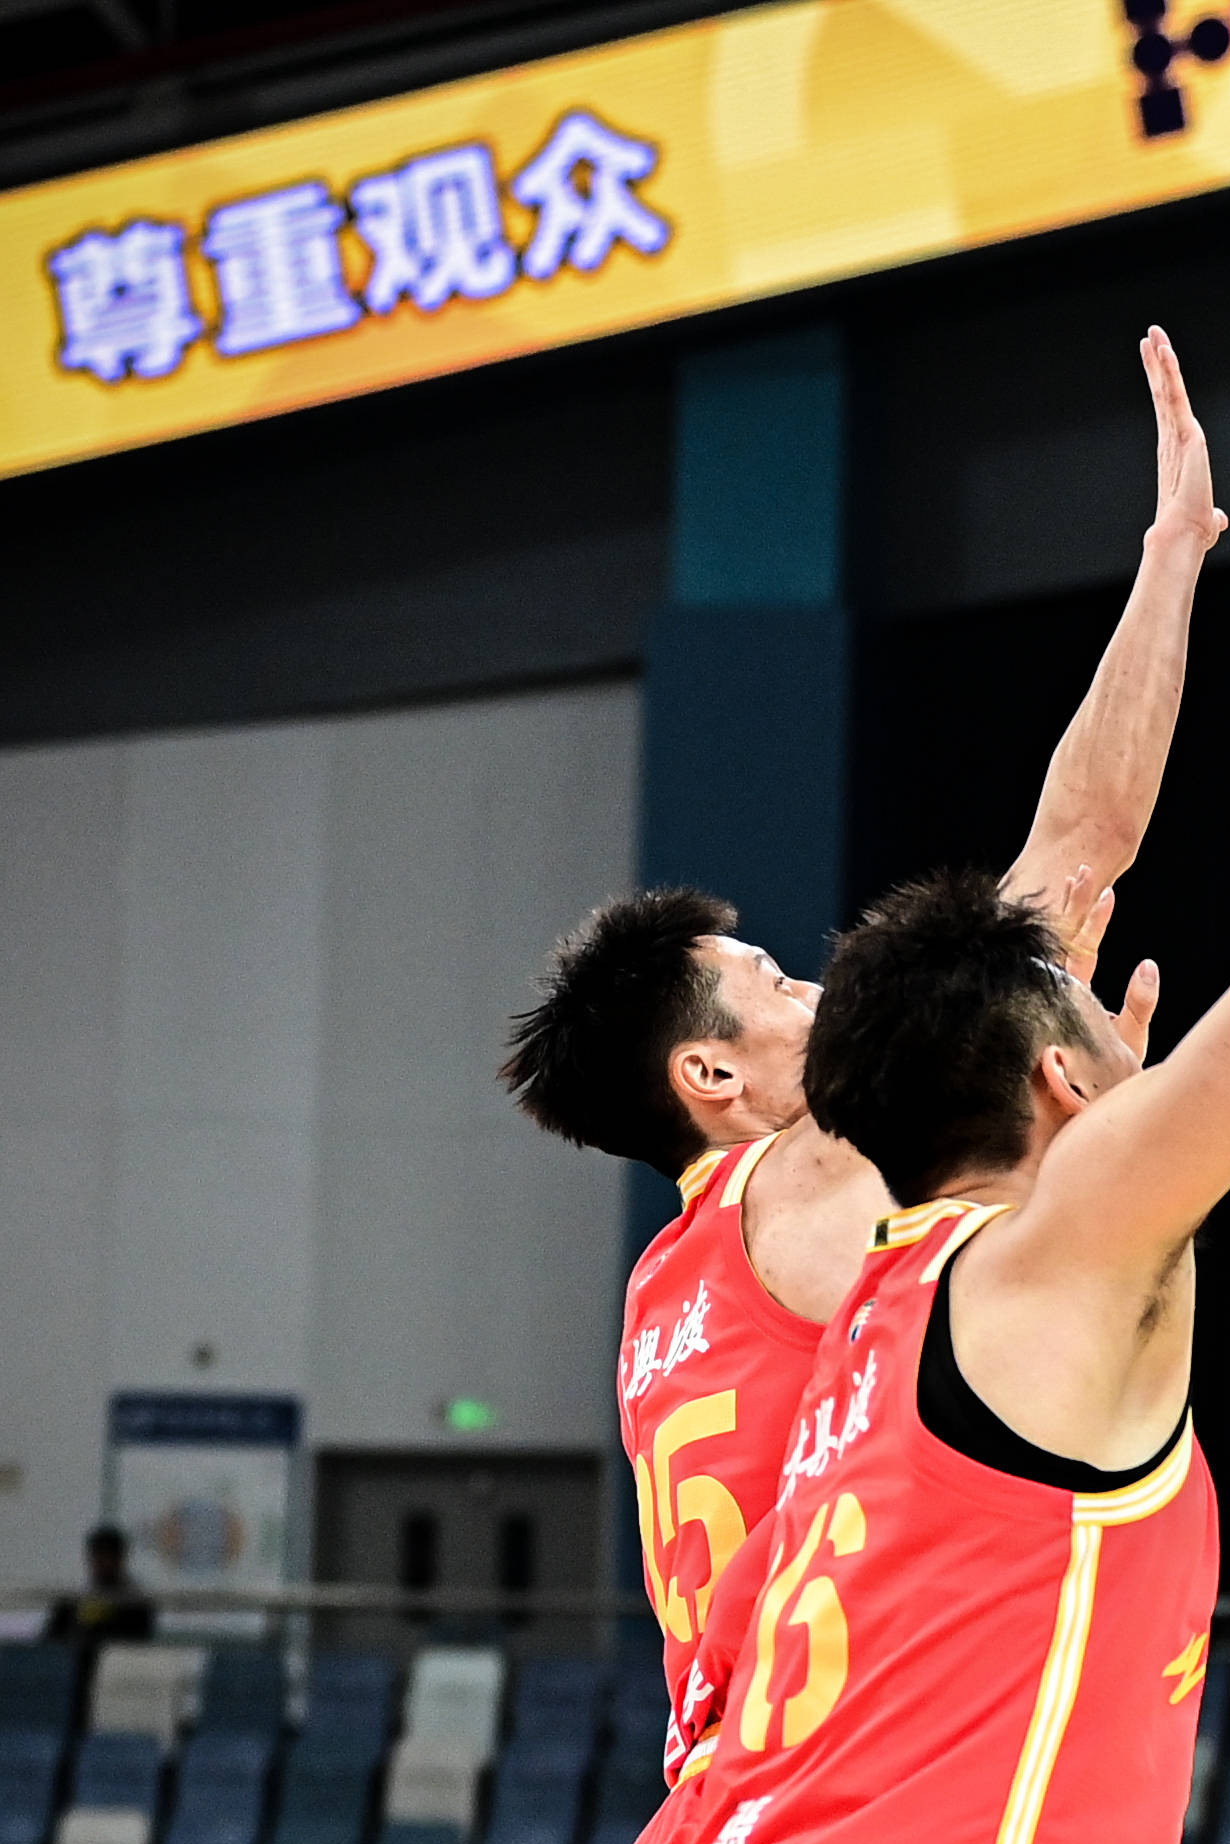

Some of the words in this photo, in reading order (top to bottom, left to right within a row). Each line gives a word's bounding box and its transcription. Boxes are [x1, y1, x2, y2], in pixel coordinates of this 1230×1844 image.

[48, 110, 670, 384] 尊重观众
[740, 1492, 867, 1752] 6
